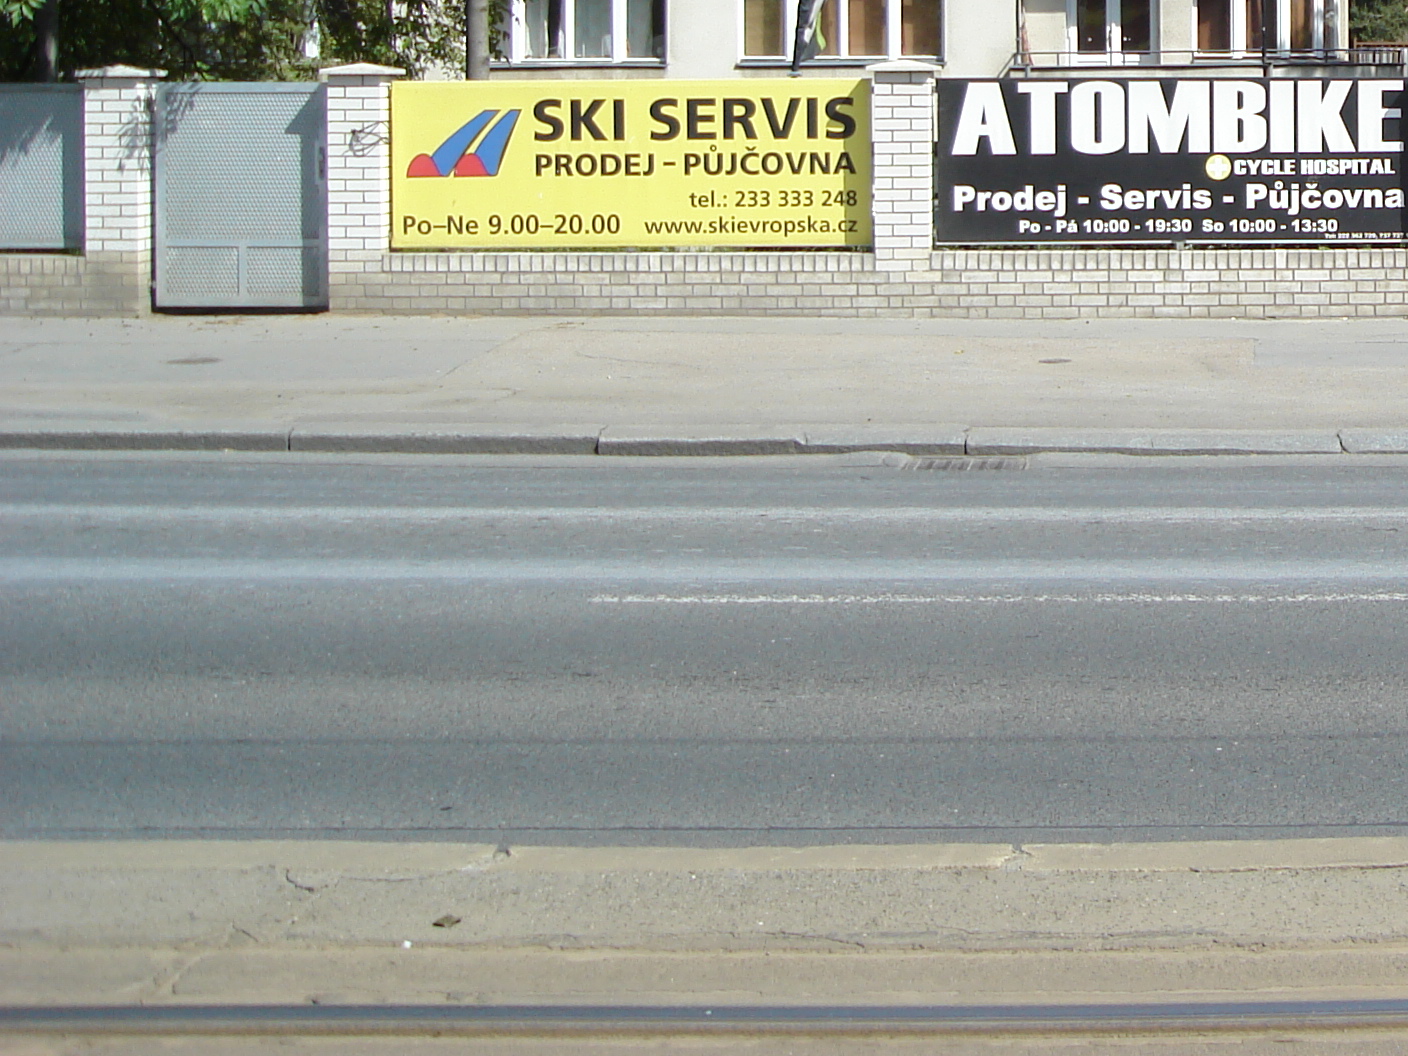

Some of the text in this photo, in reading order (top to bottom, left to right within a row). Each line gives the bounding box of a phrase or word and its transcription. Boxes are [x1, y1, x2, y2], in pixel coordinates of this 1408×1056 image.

[533, 96, 857, 142] SKI SERVIS
[951, 80, 1405, 156] ATOMBIKE
[535, 152, 654, 177] PRODEJ
[684, 144, 857, 176] PŮJČOVNA
[1233, 157, 1396, 176] CYCLE HOSPITAL
[689, 190, 858, 209] tel.: 233 333 248
[953, 184, 1067, 217] Prodej
[1100, 183, 1213, 211] Servis
[1245, 180, 1406, 216] Půjčovna
[644, 215, 858, 239] www.skievropska.cz
[1019, 220, 1042, 234] Po
[1056, 217, 1079, 234] Pá
[1083, 219, 1129, 234] 10:00
[1144, 218, 1192, 234] 19:30
[1202, 219, 1225, 234] So
[1229, 218, 1276, 234] 10:00
[1291, 218, 1338, 233] 13:30
